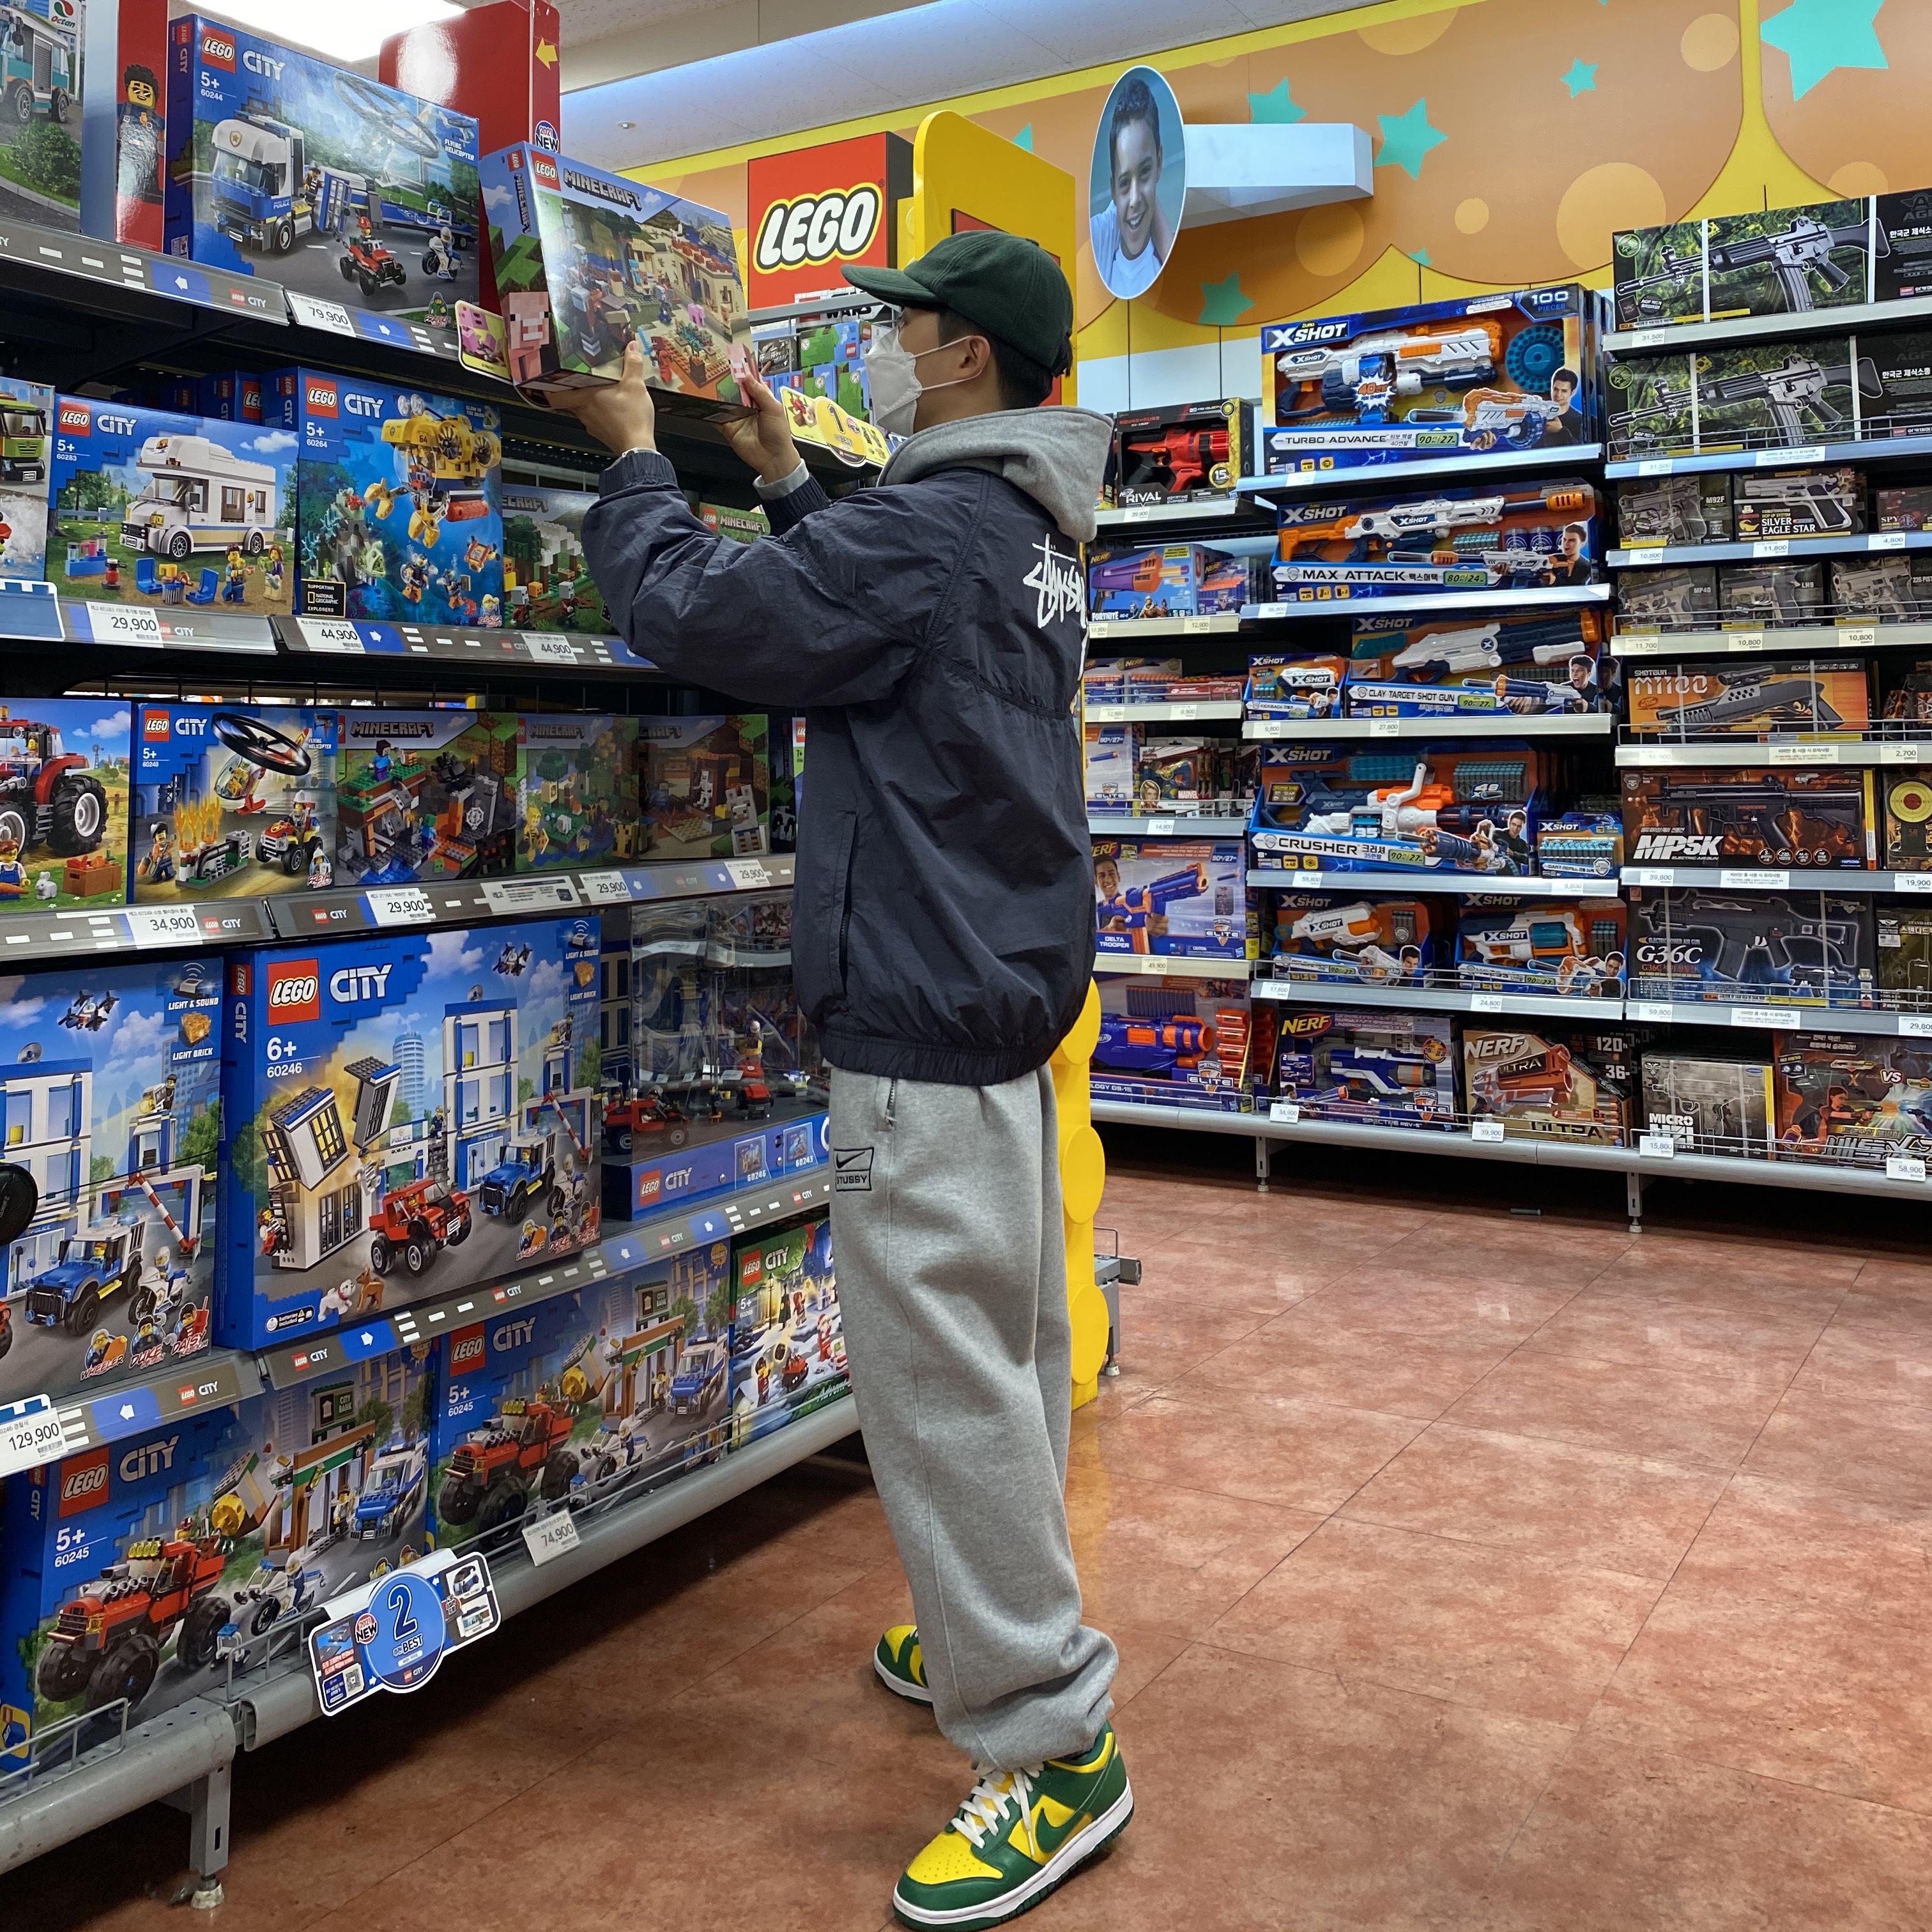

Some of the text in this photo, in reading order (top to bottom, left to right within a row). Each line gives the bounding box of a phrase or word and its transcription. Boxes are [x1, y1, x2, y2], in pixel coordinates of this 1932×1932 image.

[203, 38, 286, 80] LEGO CITY
[201, 71, 220, 89] 5+
[200, 88, 223, 102] 60244
[539, 126, 555, 137] 2021
[444, 138, 462, 150] FLYING
[535, 134, 559, 152] NEW
[445, 146, 475, 161] HELICOPTER
[534, 161, 642, 211] LEGO MINECRAFT
[514, 172, 532, 234] MINECRAFT
[756, 187, 879, 270] LEGO
[1889, 229, 1910, 239] 한국군
[247, 296, 266, 308] CITY
[1530, 290, 1569, 305] 100
[1538, 303, 1566, 312] PIECES
[308, 306, 349, 325] 79,900
[1882, 369, 1903, 379] 한국군
[307, 388, 384, 419] LEGO CITY
[284, 399, 293, 425] CITY
[59, 410, 137, 436] LEGO CITY
[306, 422, 325, 436] 5+
[57, 439, 75, 453] 5+
[306, 438, 328, 448] 60264
[1284, 434, 1387, 445] TURBO ADVANCE
[56, 453, 77, 461] 60283
[1126, 491, 1162, 503] RIVAL
[1705, 494, 1726, 505] M92F
[719, 514, 766, 533] MINECRAFT
[1761, 518, 1792, 528] SILVER
[1880, 515, 1899, 524] SPY
[1761, 523, 1816, 535] EAGLE STAR
[1883, 536, 1904, 544] 4,800
[1763, 544, 1788, 553] 11,800
[1090, 551, 1111, 564] NERF
[1302, 570, 1339, 581] MAX
[1345, 570, 1406, 582] ATTACK
[1091, 611, 1119, 622] FORTNITE
[111, 617, 157, 632] 29,900
[174, 626, 194, 636] CITY
[321, 628, 358, 641] 44,900
[541, 643, 571, 655] 44,900
[1737, 638, 1761, 647] 10,800
[1124, 658, 1145, 668] NERF
[1635, 675, 1708, 695] M1100
[1368, 689, 1455, 702] CLAY TARGET SHOT GUN
[144, 717, 208, 736] LEGO CITY
[350, 721, 434, 738] MINECRAFT
[529, 724, 586, 739] MINECRAFT
[142, 747, 157, 759] 5+
[1474, 783, 1500, 792] 48
[1354, 827, 1381, 839] 35
[1278, 838, 1358, 855] CRUSHER
[1633, 834, 1724, 861] MP5K
[739, 869, 765, 880] 29,900
[597, 882, 626, 894] 29,900
[387, 900, 425, 914] 29,900
[330, 909, 348, 920] CITY
[150, 917, 195, 932] 34,900
[222, 918, 241, 929] CITY
[1636, 944, 1703, 964] G36C
[270, 963, 392, 1006] LEGO CITY
[168, 997, 218, 1011] LIGHT SOUND
[234, 965, 247, 1043] LEGO CITY
[1281, 1015, 1332, 1036] NERF
[266, 1037, 298, 1061] 6+
[1464, 1035, 1526, 1059] NERF
[1597, 1036, 1623, 1053] 120
[172, 1048, 213, 1061] LIGHT BRICK
[266, 1061, 303, 1078] 60246
[1498, 1057, 1543, 1075] ULTRA
[1604, 1064, 1627, 1080] 36
[1188, 1075, 1234, 1086] ELITE
[1882, 1070, 1902, 1083] VS
[1404, 1105, 1448, 1114] ELITE
[1361, 1117, 1400, 1127] SPECTRE
[1648, 1112, 1694, 1126] MICRO
[1480, 1128, 1502, 1137] 39,900
[795, 1155, 814, 1167] 60243
[746, 1170, 767, 1182] 60246
[1898, 1165, 1924, 1174] 58,900
[640, 1167, 693, 1197] LEGO CITY
[743, 1246, 790, 1277] LEGO CITY
[506, 1285, 523, 1297] CITY
[657, 1292, 667, 1301] CITY
[656, 1298, 667, 1308] BANK
[740, 1297, 752, 1310] 5+
[451, 1316, 537, 1363] LEGO CITY
[295, 1348, 328, 1367] LEGO CITY
[80, 1354, 125, 1381] WHEELER
[181, 1381, 218, 1400] LEGO CITY
[448, 1386, 470, 1404] 5+
[339, 1393, 353, 1405] CITY
[338, 1402, 354, 1413] BANK
[448, 1402, 474, 1418] 60245
[8, 1422, 60, 1452] 129,900
[62, 1435, 180, 1499] LEGO CITY
[55, 1527, 86, 1552] 5+
[540, 1522, 575, 1548] 74,900
[54, 1547, 90, 1568] 60245
[388, 1583, 418, 1641] 2
[358, 1617, 372, 1629] 2021
[355, 1623, 378, 1643] NEW
[402, 1634, 423, 1653] BEST
